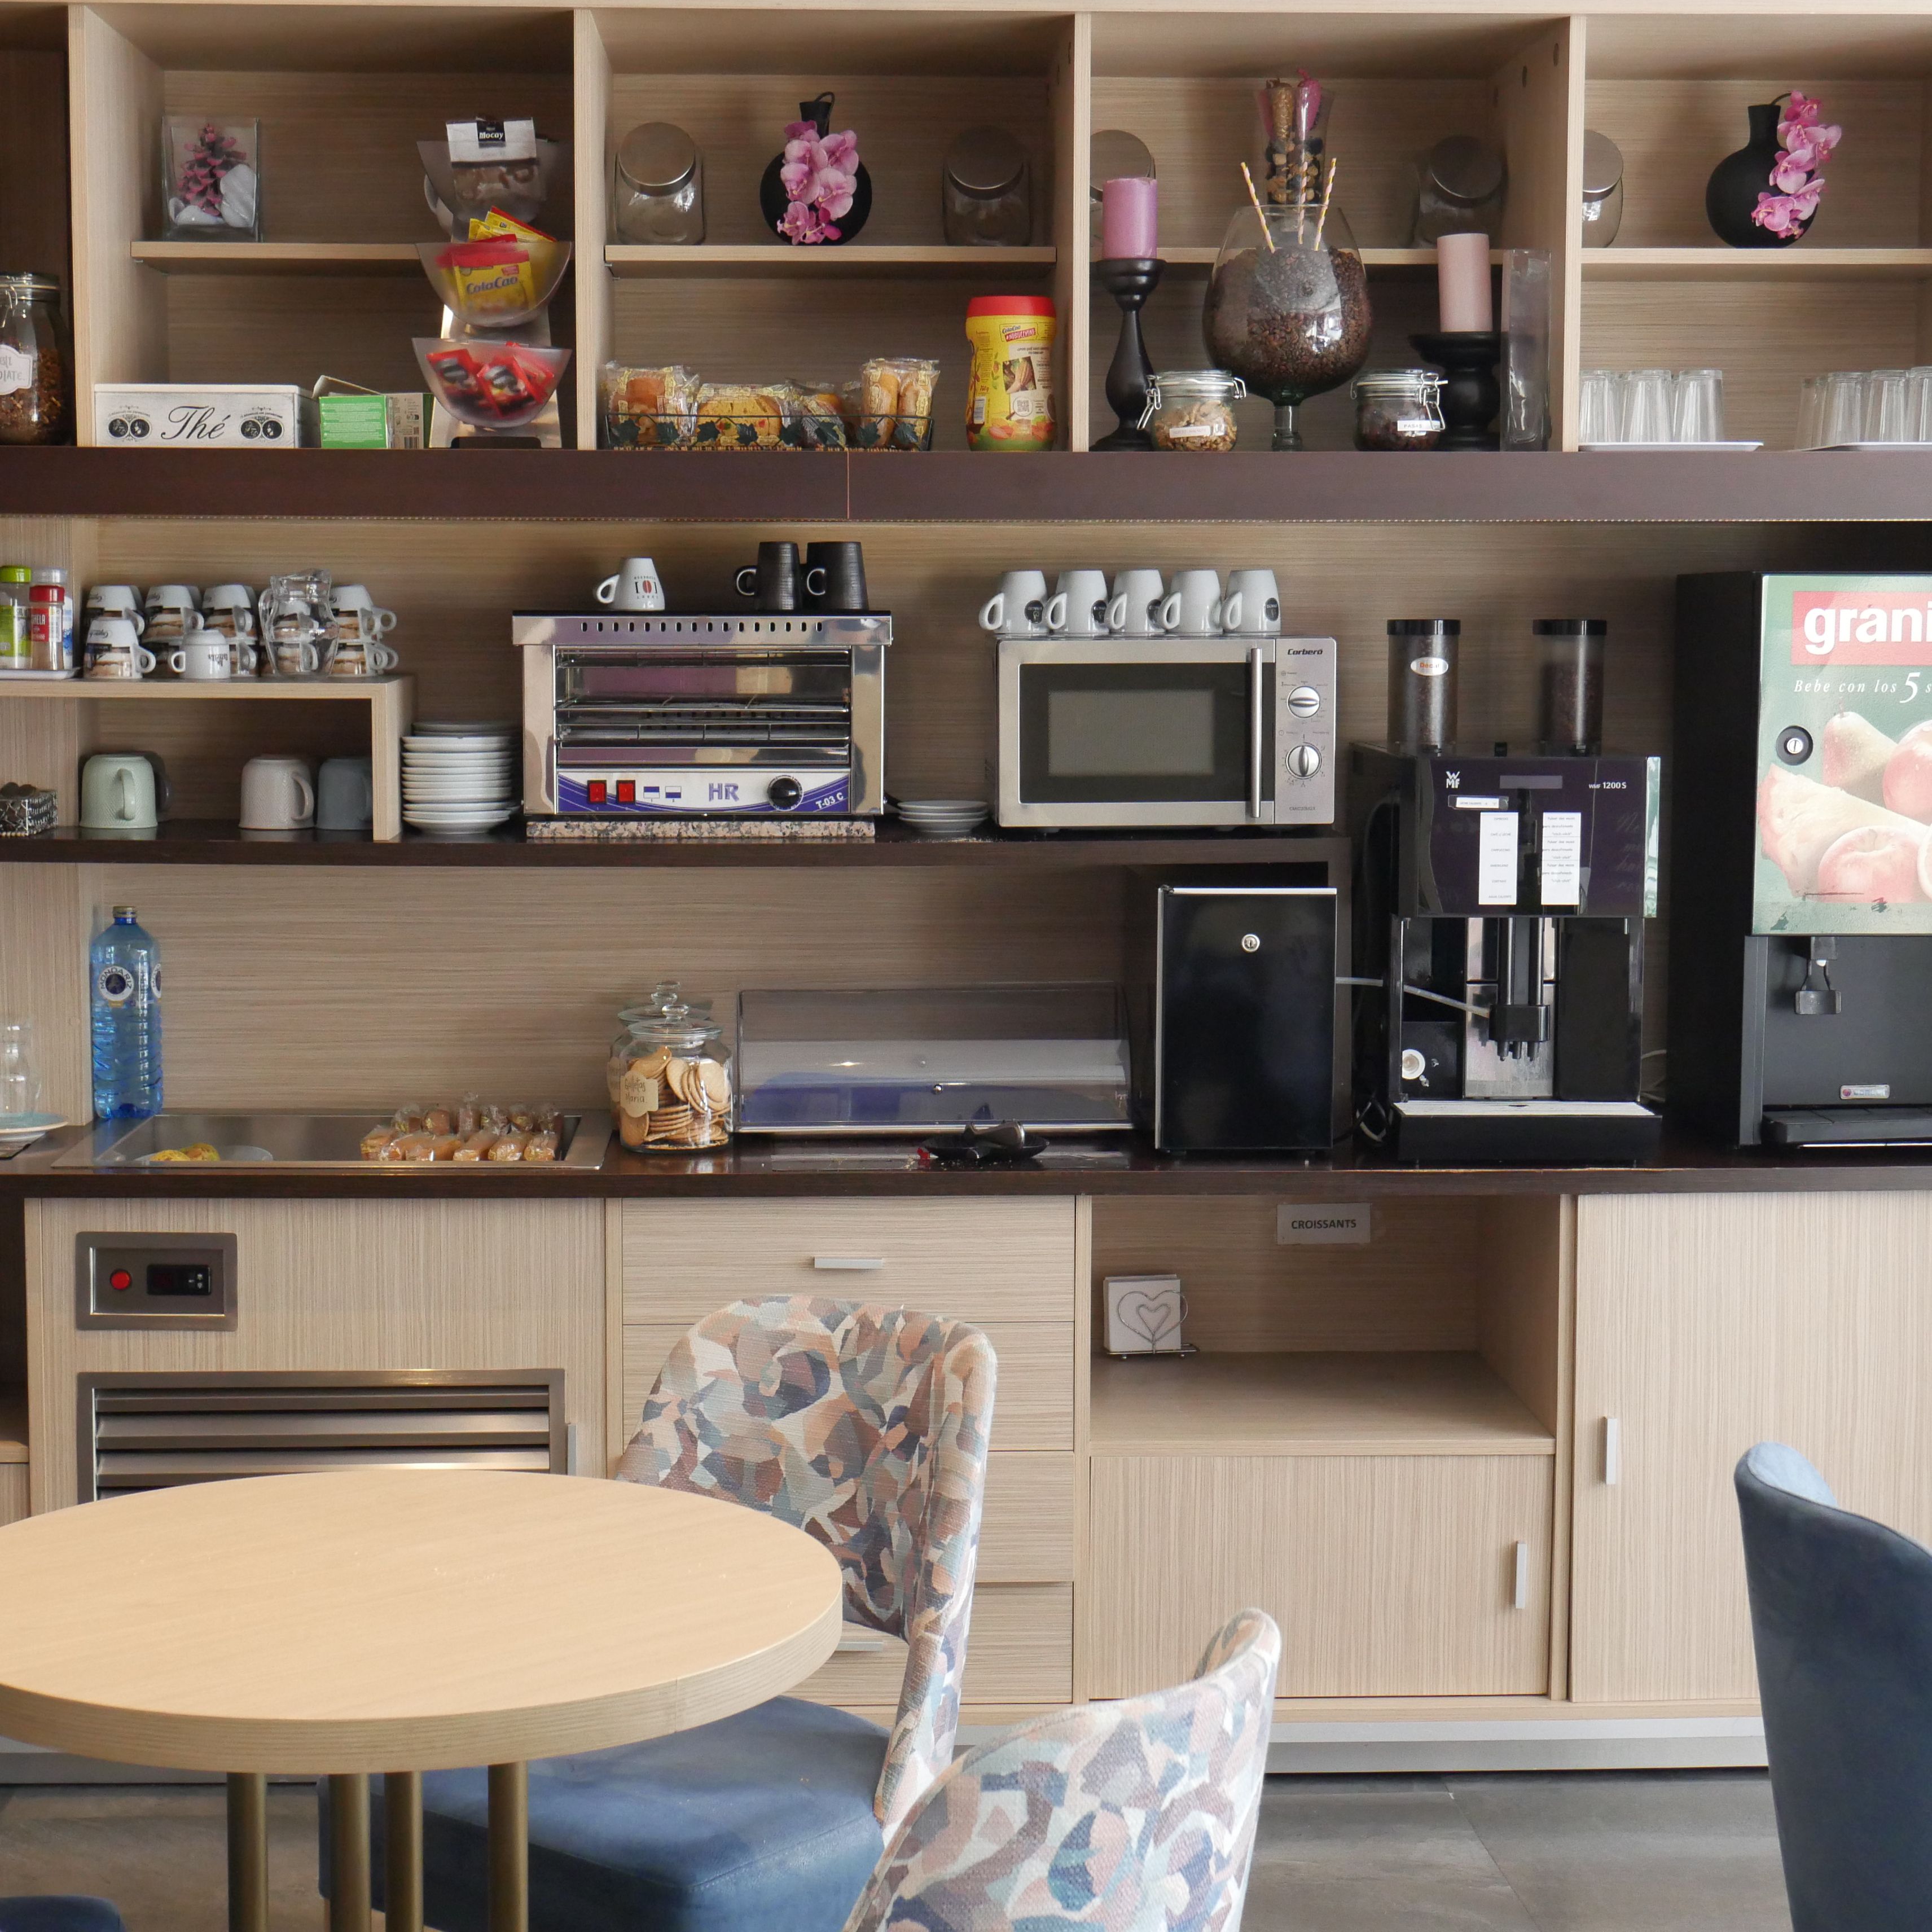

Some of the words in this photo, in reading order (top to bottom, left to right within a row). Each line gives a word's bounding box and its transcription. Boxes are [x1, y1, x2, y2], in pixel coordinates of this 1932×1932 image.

[479, 131, 504, 140] Mocay
[467, 276, 512, 295] ColaCao
[161, 406, 231, 440] Thé
[1804, 601, 1932, 655] grani
[1794, 679, 1831, 693] Bebe
[1839, 683, 1865, 693] con
[1874, 679, 1897, 693] los
[1899, 671, 1921, 704] 5
[709, 783, 740, 802] HR
[100, 967, 133, 990] MONDARIZ
[1291, 1219, 1357, 1230] CROISSANTS
